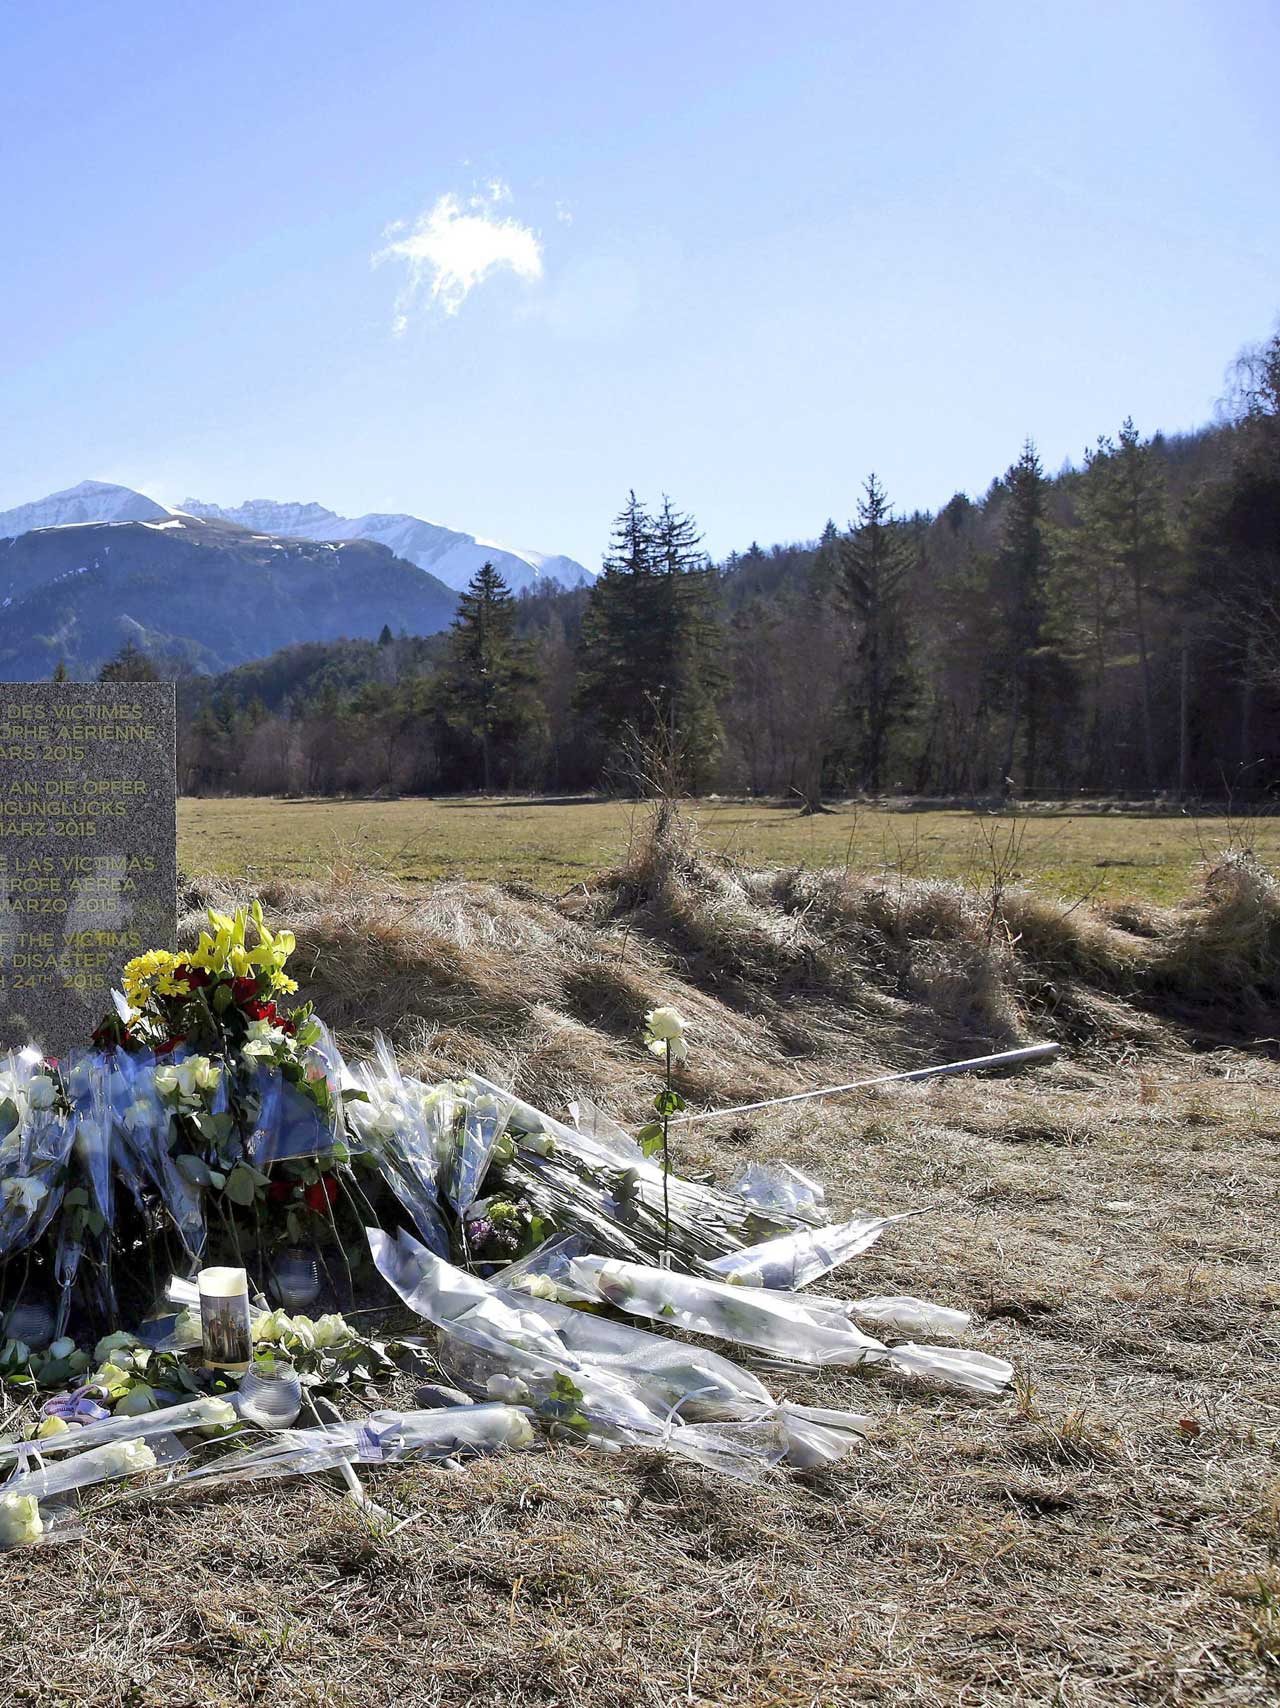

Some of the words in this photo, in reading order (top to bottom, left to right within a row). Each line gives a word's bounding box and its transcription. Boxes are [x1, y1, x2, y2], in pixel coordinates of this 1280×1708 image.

[7, 703, 45, 719] DES
[52, 703, 142, 719] VICTIMES
[43, 746, 85, 760] 2015
[10, 781, 37, 795] AN
[46, 781, 75, 795] DIE
[83, 781, 146, 795] OPFER
[55, 822, 96, 836] 2015
[16, 857, 54, 872] LAS
[75, 898, 117, 912] 2015
[17, 933, 55, 947] THE
[62, 931, 141, 947] VICTIMS
[13, 953, 108, 968] DISASTER
[63, 974, 105, 988] 2015
